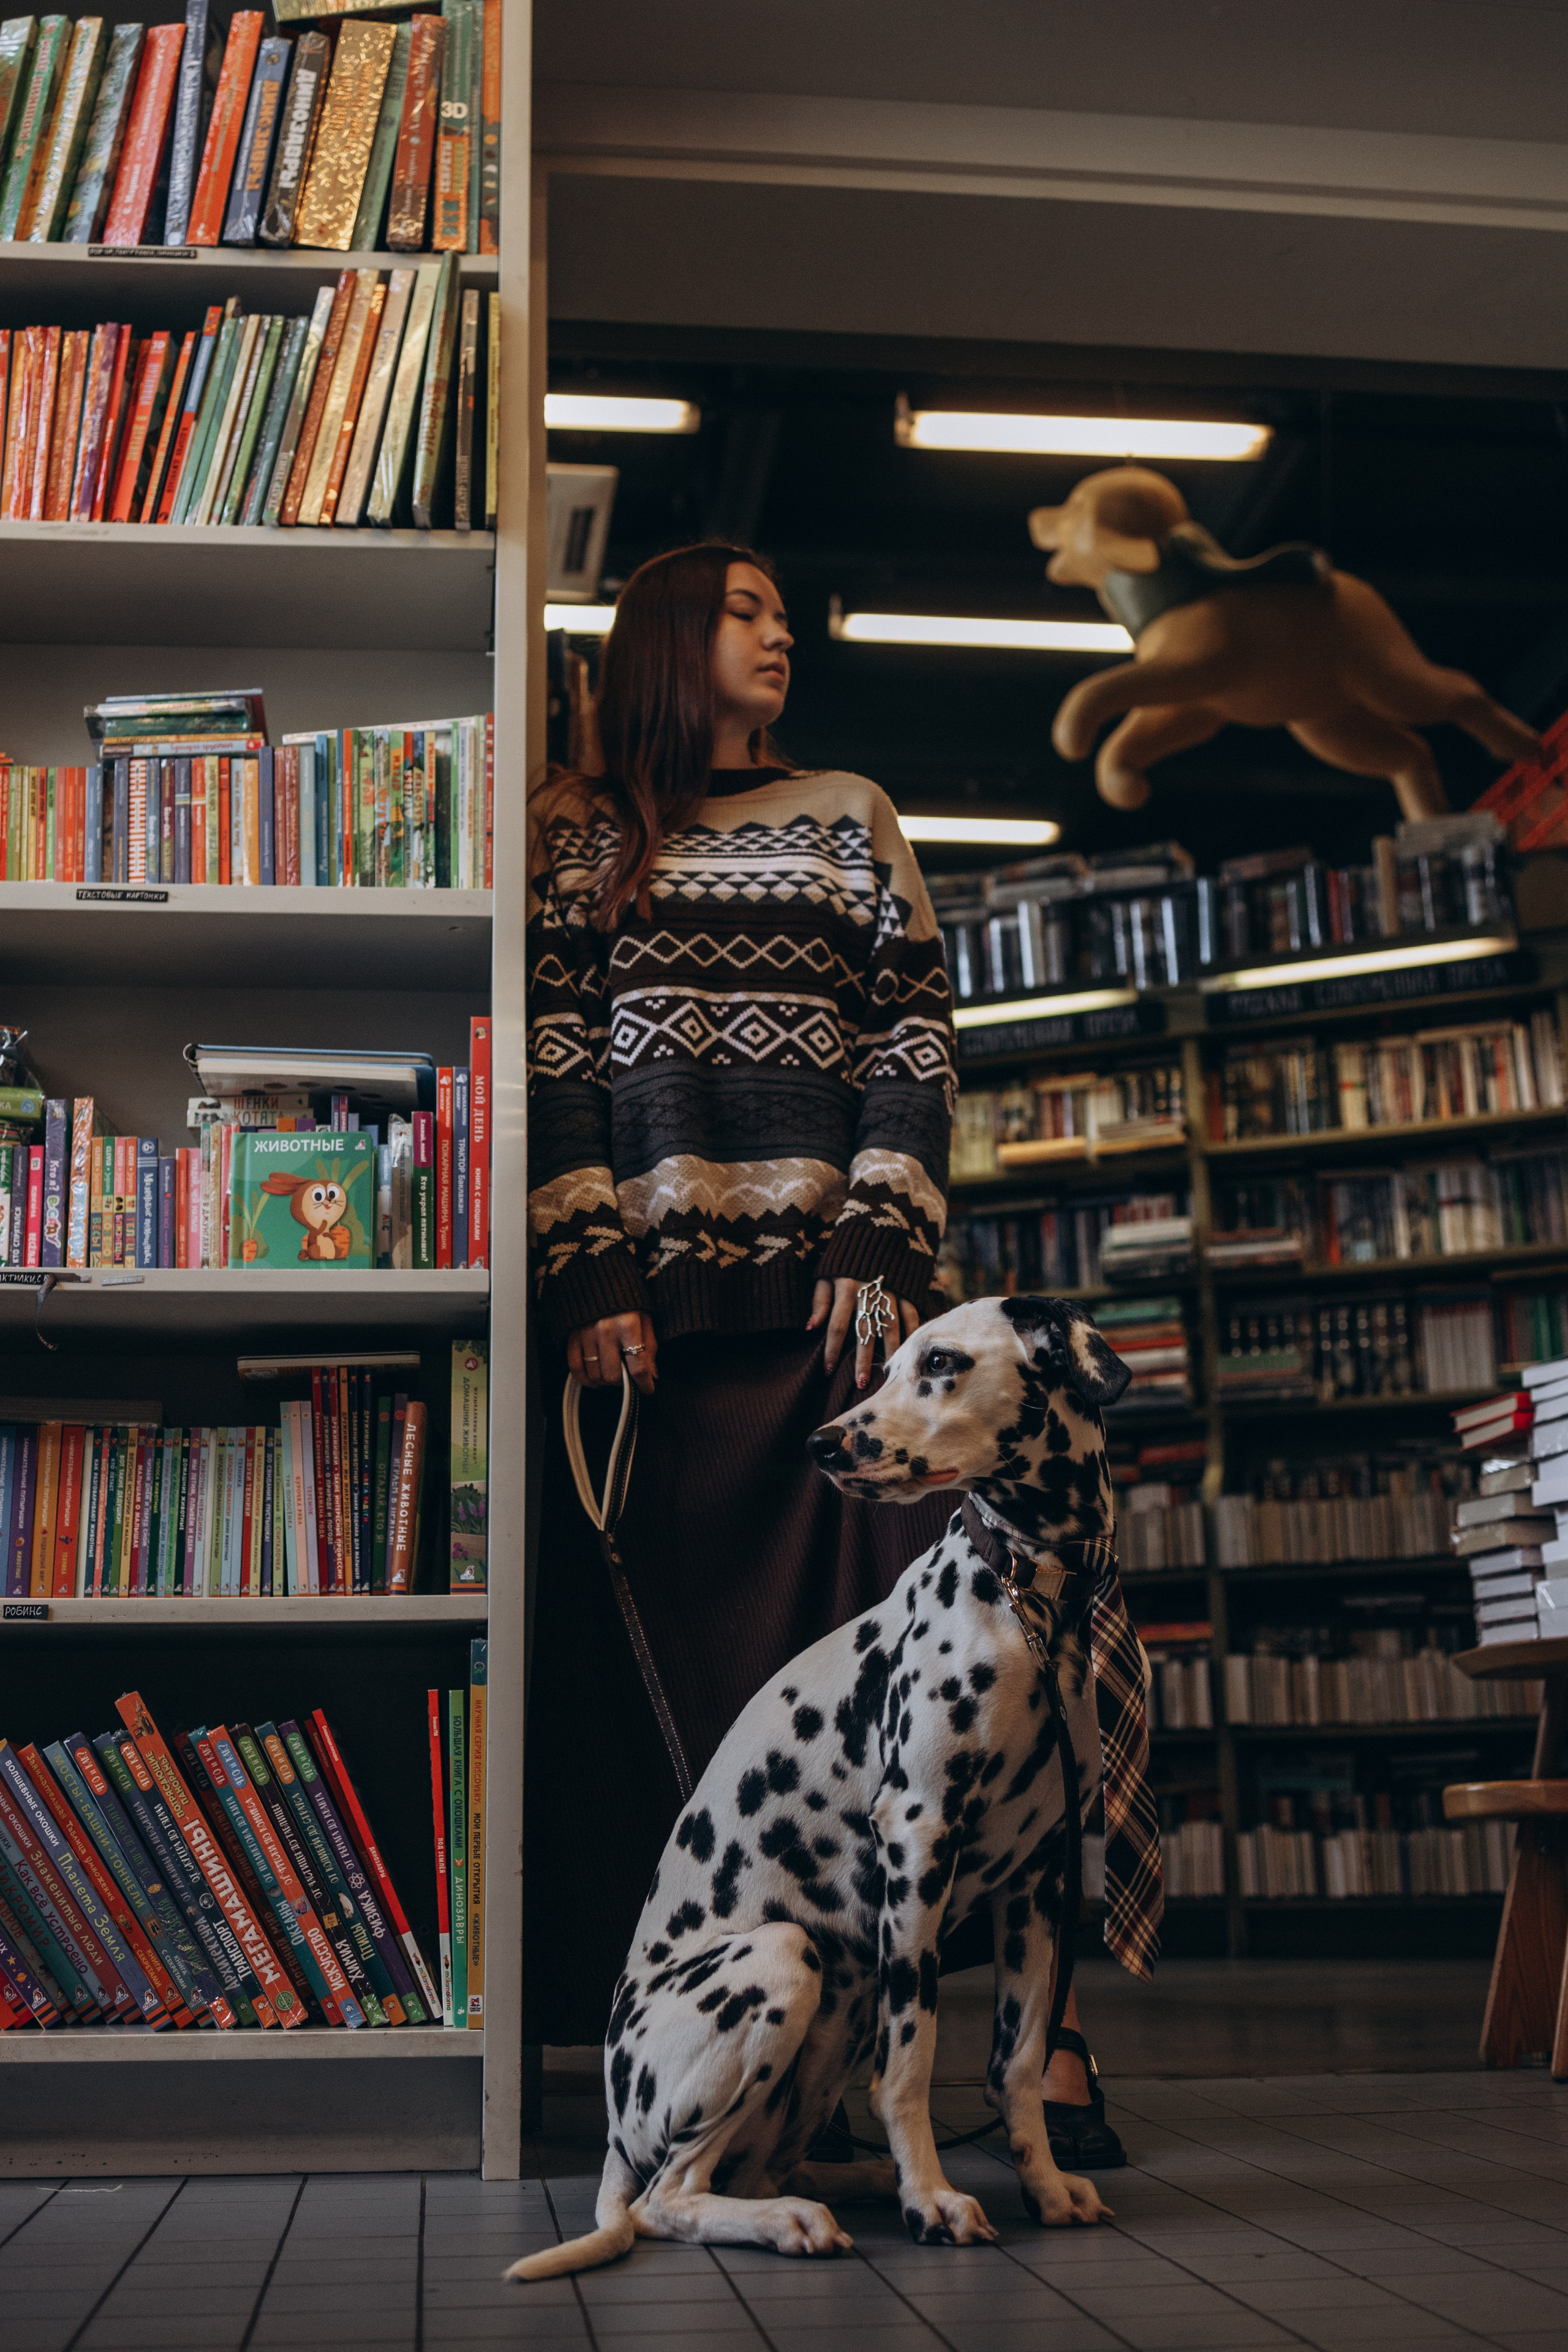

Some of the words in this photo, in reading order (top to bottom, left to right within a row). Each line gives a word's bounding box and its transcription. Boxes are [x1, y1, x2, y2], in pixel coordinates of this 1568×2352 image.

[19, 75, 44, 140] КОШКИН
[33, 39, 53, 72] ДОМ
[440, 100, 469, 119] 3D
[247, 80, 280, 190] ДИНОЗАВРЫ
[277, 69, 317, 189] ДИНОЗАВРЫ
[78, 890, 123, 900] ТЕКСТОВЫЕ
[126, 891, 165, 900] КАРТОЧКИ
[474, 1075, 486, 1105] МОЙ
[473, 1109, 484, 1143] ДЕНЬ
[254, 1139, 344, 1153] ЖИВОТНЫЕ
[440, 1139, 449, 1184] ПОЖАРНАЯ
[458, 1138, 466, 1173] ТРАКТОР
[49, 1160, 59, 1177] Кто
[49, 1180, 58, 1191] я?
[418, 1192, 427, 1216] украл
[458, 1175, 466, 1214] Баклажан
[126, 1216, 135, 1251] ТЕЛЕЦ
[473, 1199, 481, 1240] ОКОШКАМИ
[114, 1215, 123, 1262] БЛИЗНЕЦЫ
[462, 1378, 471, 1427] ДОМАШНИЕ
[20, 1438, 28, 1488] ЗАНИМАТЕЛЬНЫЕ
[266, 1453, 272, 1463] ДО
[402, 1423, 417, 1476] ЛЕСНЫЕ
[462, 1429, 471, 1474] ЖИВОТНЫЕ
[376, 1511, 385, 1529] КТО
[396, 1483, 412, 1551] ЖИВОТНЫЕ
[5, 1605, 42, 1616] РОБИНС
[145, 1749, 186, 1819] ПОТРЯСАЮЩИЕ
[158, 1753, 190, 1805] ПАНОРАМЫ
[453, 1759, 462, 1785] КНИГА
[4, 1758, 38, 1811] ВОЛШЕБНЫЕ
[34, 1809, 59, 1847] ОКОШКИ
[153, 1803, 172, 1830] ТЯГАЧА
[225, 1795, 240, 1816] КИТА
[314, 1792, 331, 1819] КВАНТА
[26, 1752, 69, 1819] Занимательная
[64, 1820, 88, 1855] Таблица
[84, 1855, 115, 1902] умножения
[53, 1753, 83, 1798] МОСТЫ
[81, 1803, 111, 1847] БАШНИ
[108, 1852, 145, 1908] ТОННЕЛИ
[166, 1828, 179, 1841] ДО
[235, 1815, 246, 1827] ДО
[271, 1803, 294, 1839] ТАБЛИЦЫ
[326, 1818, 337, 1830] ДО
[454, 1798, 463, 1847] ОКОШКАМИ
[156, 1844, 167, 1856] ДО
[172, 1841, 194, 1872] СКУТЕРА
[241, 1828, 267, 1872] ПЛАНКТОНА
[288, 1838, 300, 1851] ДО
[331, 1830, 349, 1858] РЫЧАГА
[437, 1850, 446, 1873] ЗЕМЛЁЙ
[162, 1855, 184, 1890] ХИЖИНЫ
[188, 1871, 200, 1884] ОТ
[262, 1871, 273, 1883] ОТ
[294, 1850, 317, 1887] ЧАСТИЦЫ
[344, 1858, 355, 1870] ОТ
[30, 1850, 86, 1932] Знаменитые
[80, 1933, 104, 1966] люди
[57, 1852, 100, 1914] Планета
[92, 1913, 128, 1962] Земля
[179, 1891, 191, 1902] ОТ
[183, 1818, 281, 1985] МЕГАМАШИНЫ
[311, 1887, 323, 1899] ОТ
[454, 1876, 465, 1943] ДИНОЗАВРЫ
[13, 1858, 37, 1886] Как
[29, 1884, 50, 1909] всё
[44, 1910, 89, 1975] устроено
[274, 1899, 306, 1947] ОКЕАНЫ
[357, 1888, 386, 1940] ФИЗИКА
[306, 1925, 345, 1991] ИСКУССТВО
[349, 1921, 376, 1961] ПТИЦЫ
[135, 1948, 162, 1988] СЕКРЕТАМИ
[146, 1948, 162, 1972] КНИГА
[334, 1938, 360, 1984] ХИМИЯ
